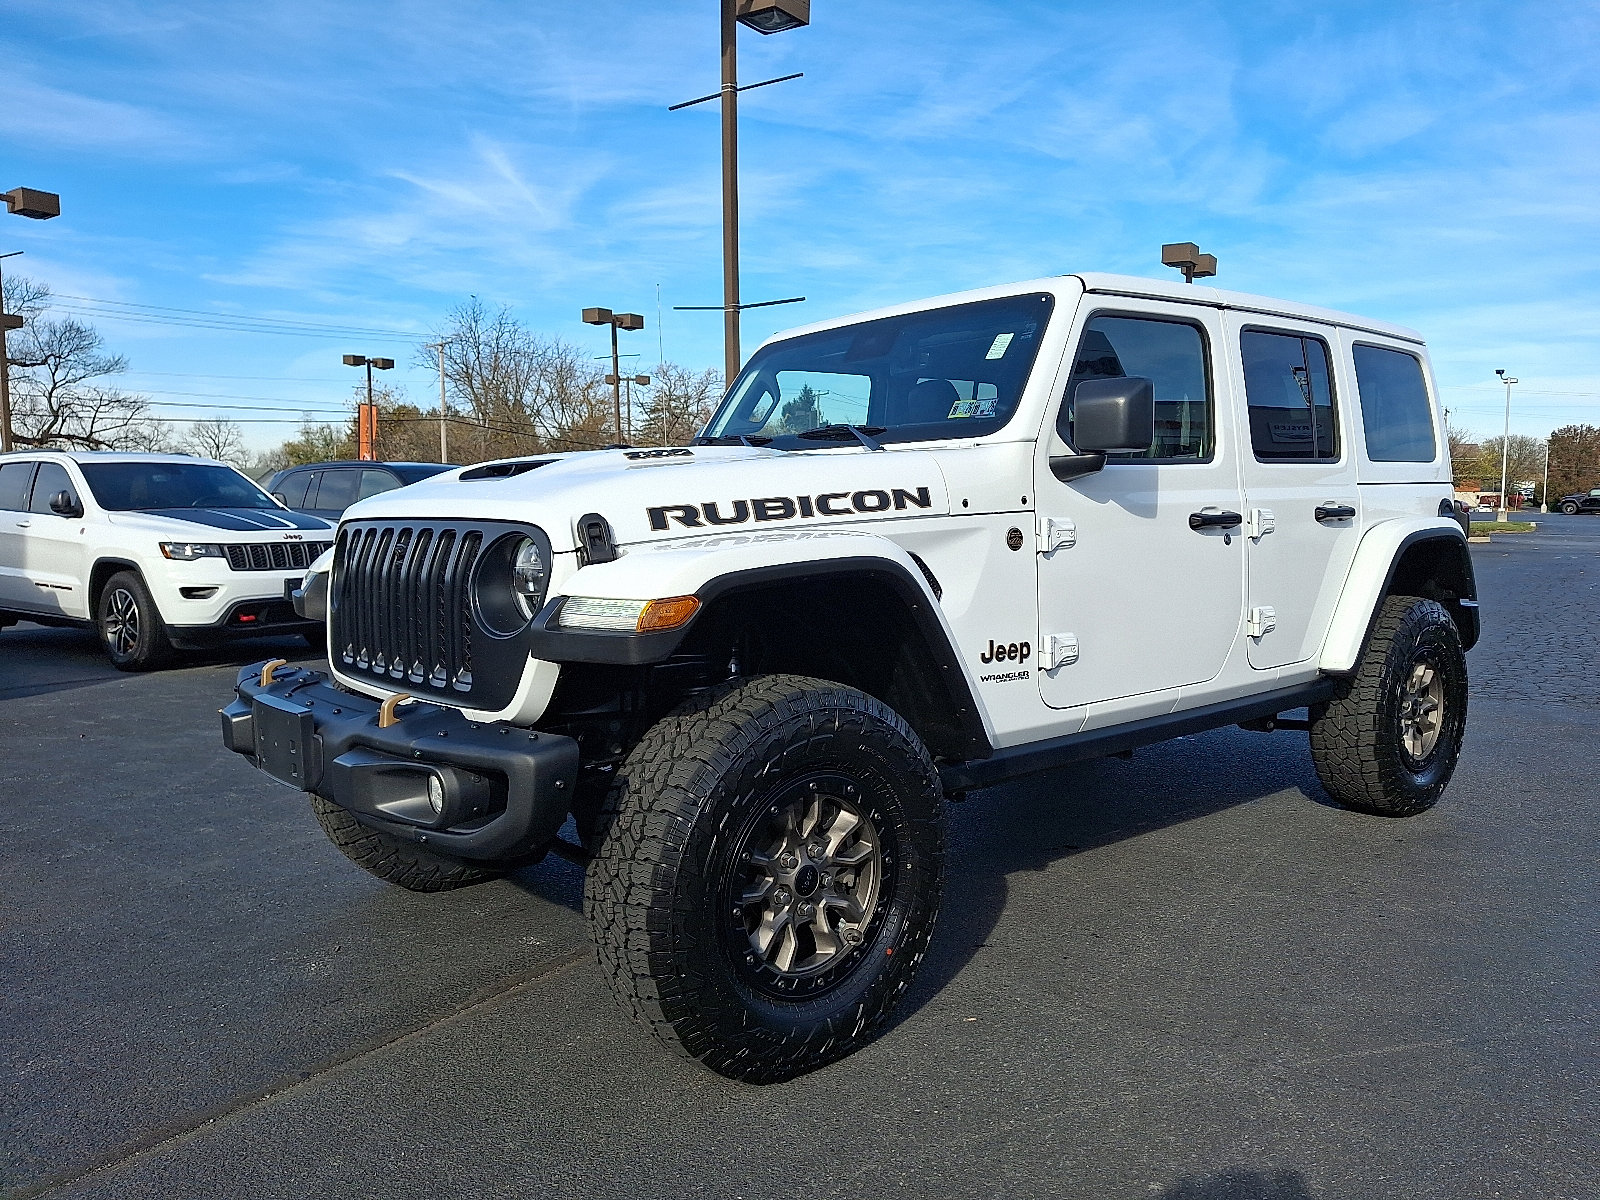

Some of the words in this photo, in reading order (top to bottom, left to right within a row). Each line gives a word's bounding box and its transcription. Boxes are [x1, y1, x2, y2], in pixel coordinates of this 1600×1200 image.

[646, 487, 932, 531] RUBICON
[283, 533, 303, 541] Jeep
[980, 640, 1031, 664] Jeep
[980, 670, 1030, 682] WRANGLER
